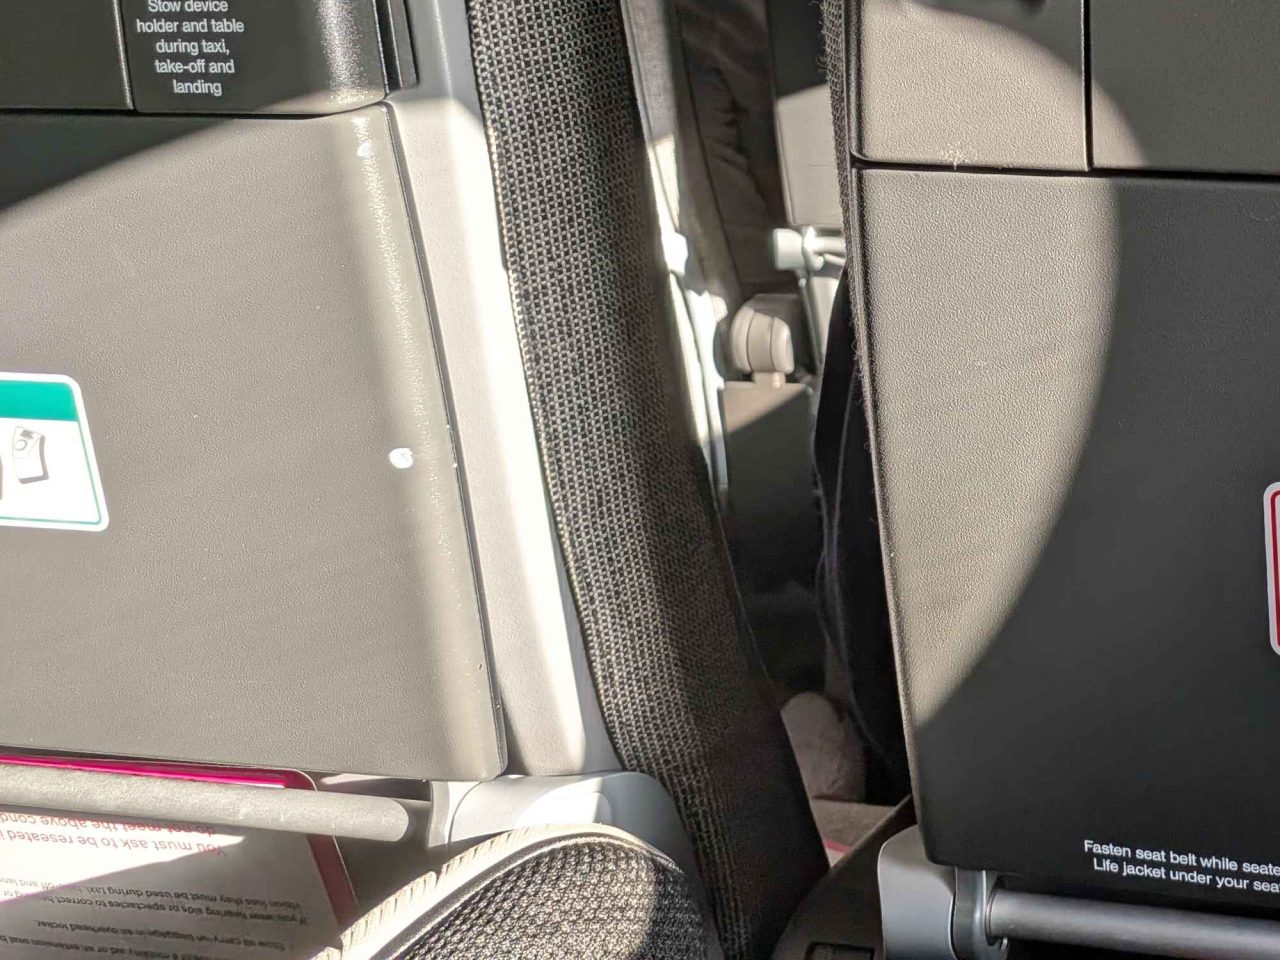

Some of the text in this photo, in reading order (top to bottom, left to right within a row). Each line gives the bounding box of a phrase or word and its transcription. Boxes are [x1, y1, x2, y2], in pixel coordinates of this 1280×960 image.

[136, 18, 245, 32] holder and table
[156, 38, 230, 56] during taxi,
[155, 58, 235, 73] take-off and
[172, 79, 222, 96] landing
[41, 815, 86, 830] above
[91, 820, 117, 832] the
[9, 829, 73, 846] reseated
[78, 834, 97, 848] be
[101, 836, 116, 849] to
[122, 837, 148, 850] ask
[153, 841, 192, 854] must
[196, 842, 227, 856] You
[1084, 839, 1131, 858] Fasten
[1135, 849, 1166, 862] seat
[1169, 851, 1197, 866] belt
[1200, 856, 1238, 871] while
[1093, 857, 1119, 872] Life
[1122, 861, 1166, 879] jacket
[1169, 869, 1212, 885] under
[1215, 875, 1250, 889] your
[108, 886, 143, 899] during
